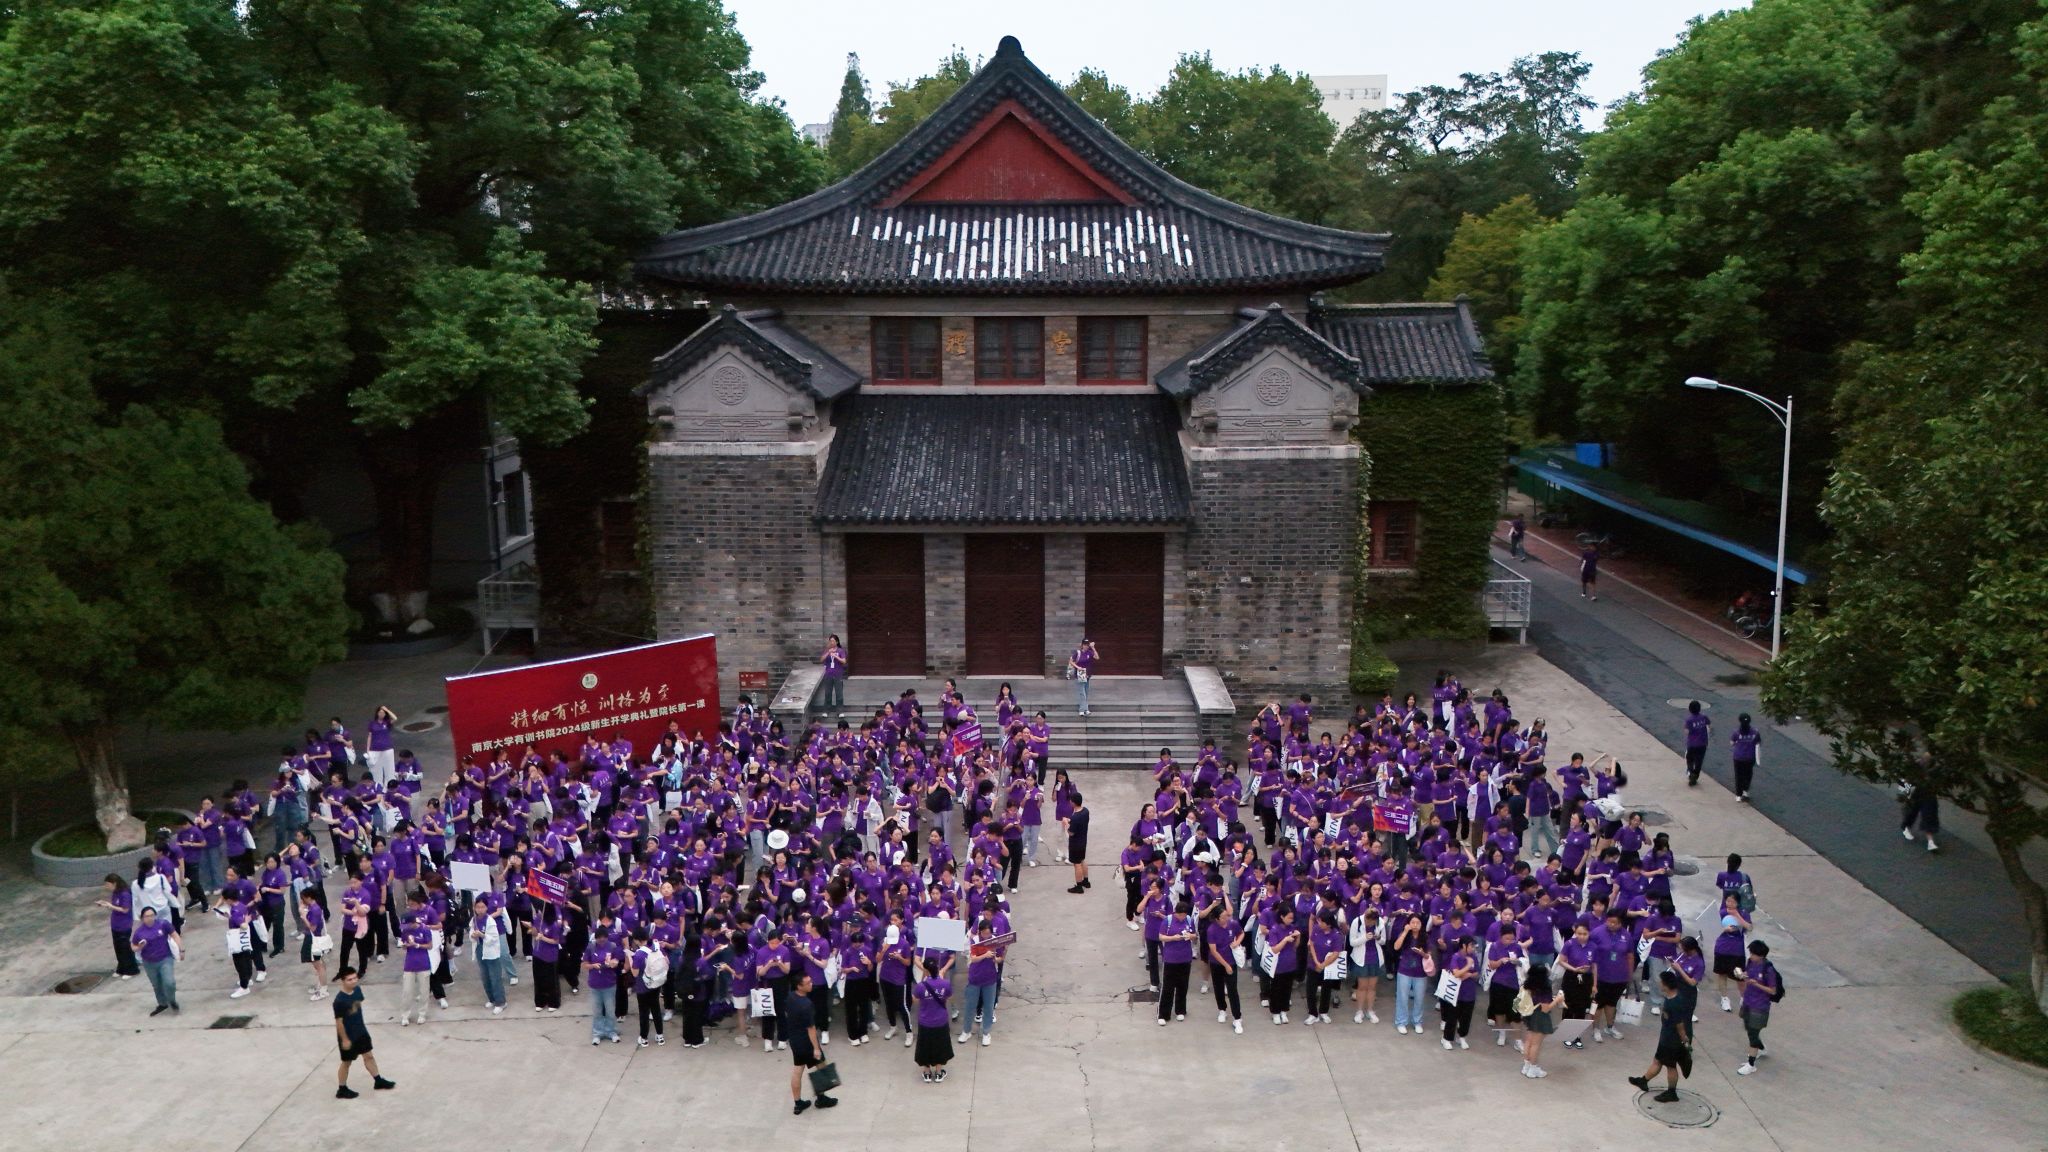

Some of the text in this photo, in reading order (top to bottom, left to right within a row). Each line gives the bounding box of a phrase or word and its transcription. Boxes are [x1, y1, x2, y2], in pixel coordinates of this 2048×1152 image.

[471, 698, 706, 753] 南京大学有训书院2024级新生开学典礼暨院长第一课
[510, 699, 591, 729] 精细有恒
[239, 931, 251, 952] NJU
[1336, 956, 1347, 979] NJU
[761, 994, 773, 1016] NJU
